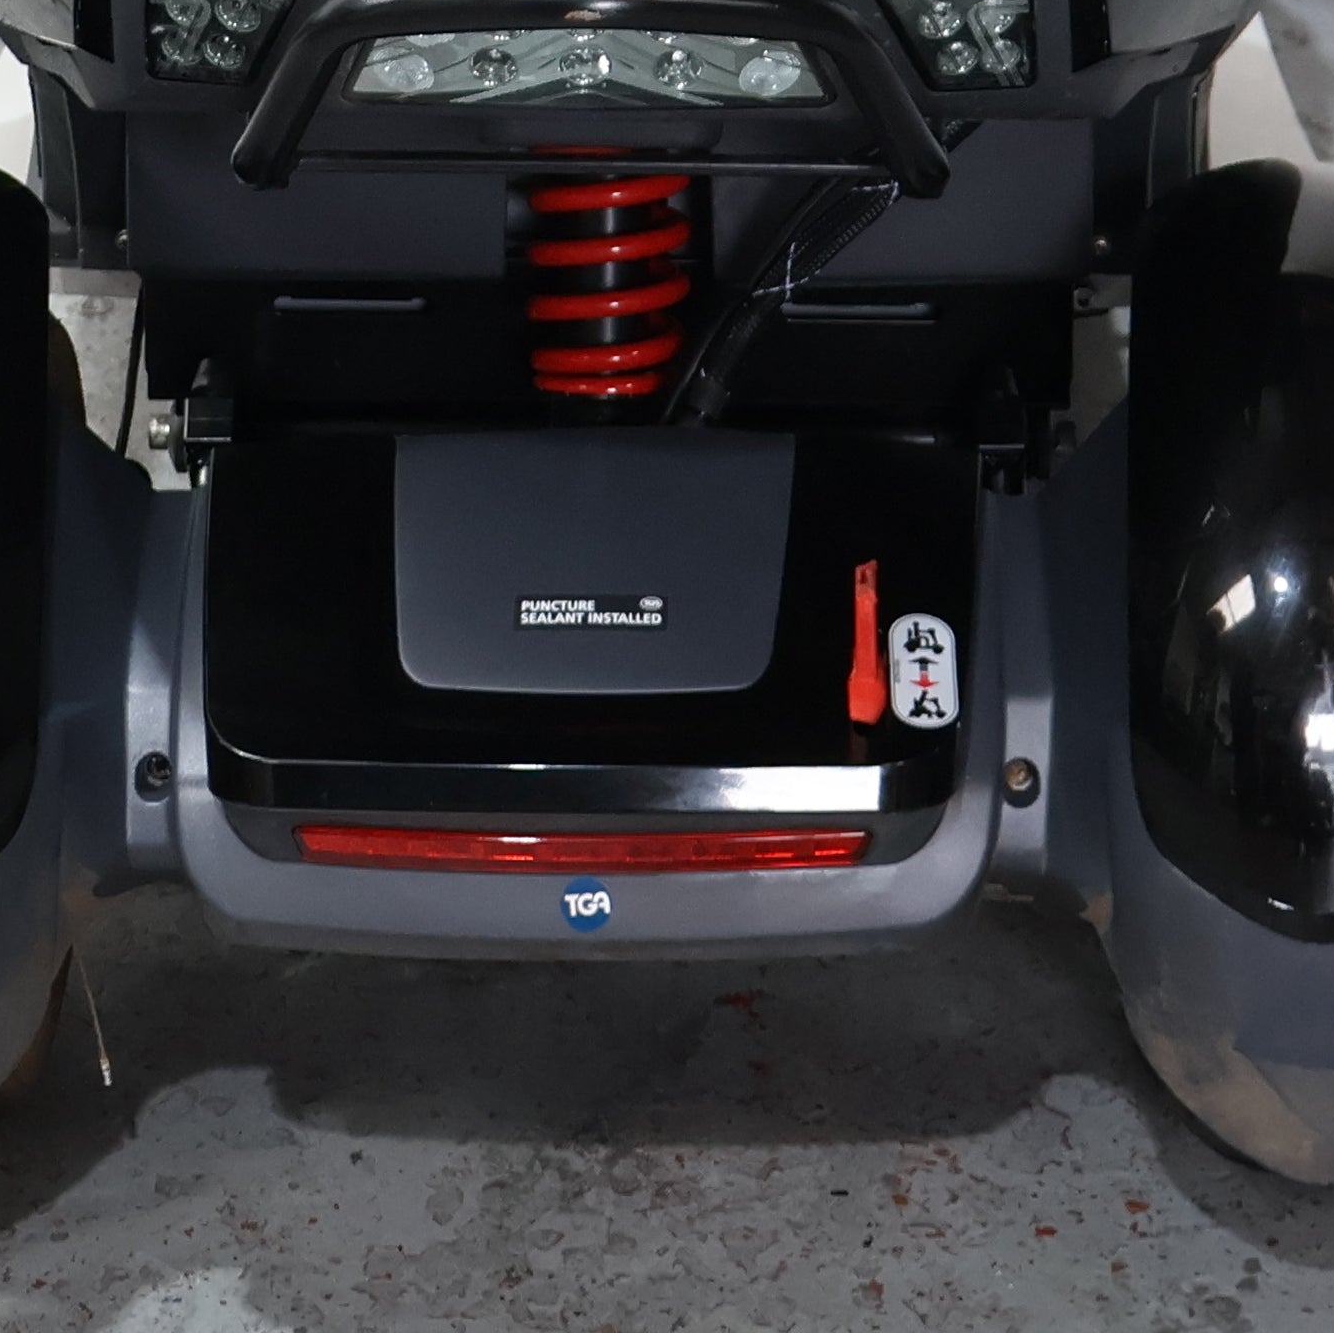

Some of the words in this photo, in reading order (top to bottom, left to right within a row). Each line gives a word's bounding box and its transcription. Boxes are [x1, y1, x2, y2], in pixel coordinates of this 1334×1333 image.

[521, 599, 595, 611] PUNCTURE
[520, 612, 584, 624] SEALANT
[587, 612, 662, 625] INSTALLED
[564, 891, 611, 917] TGA
